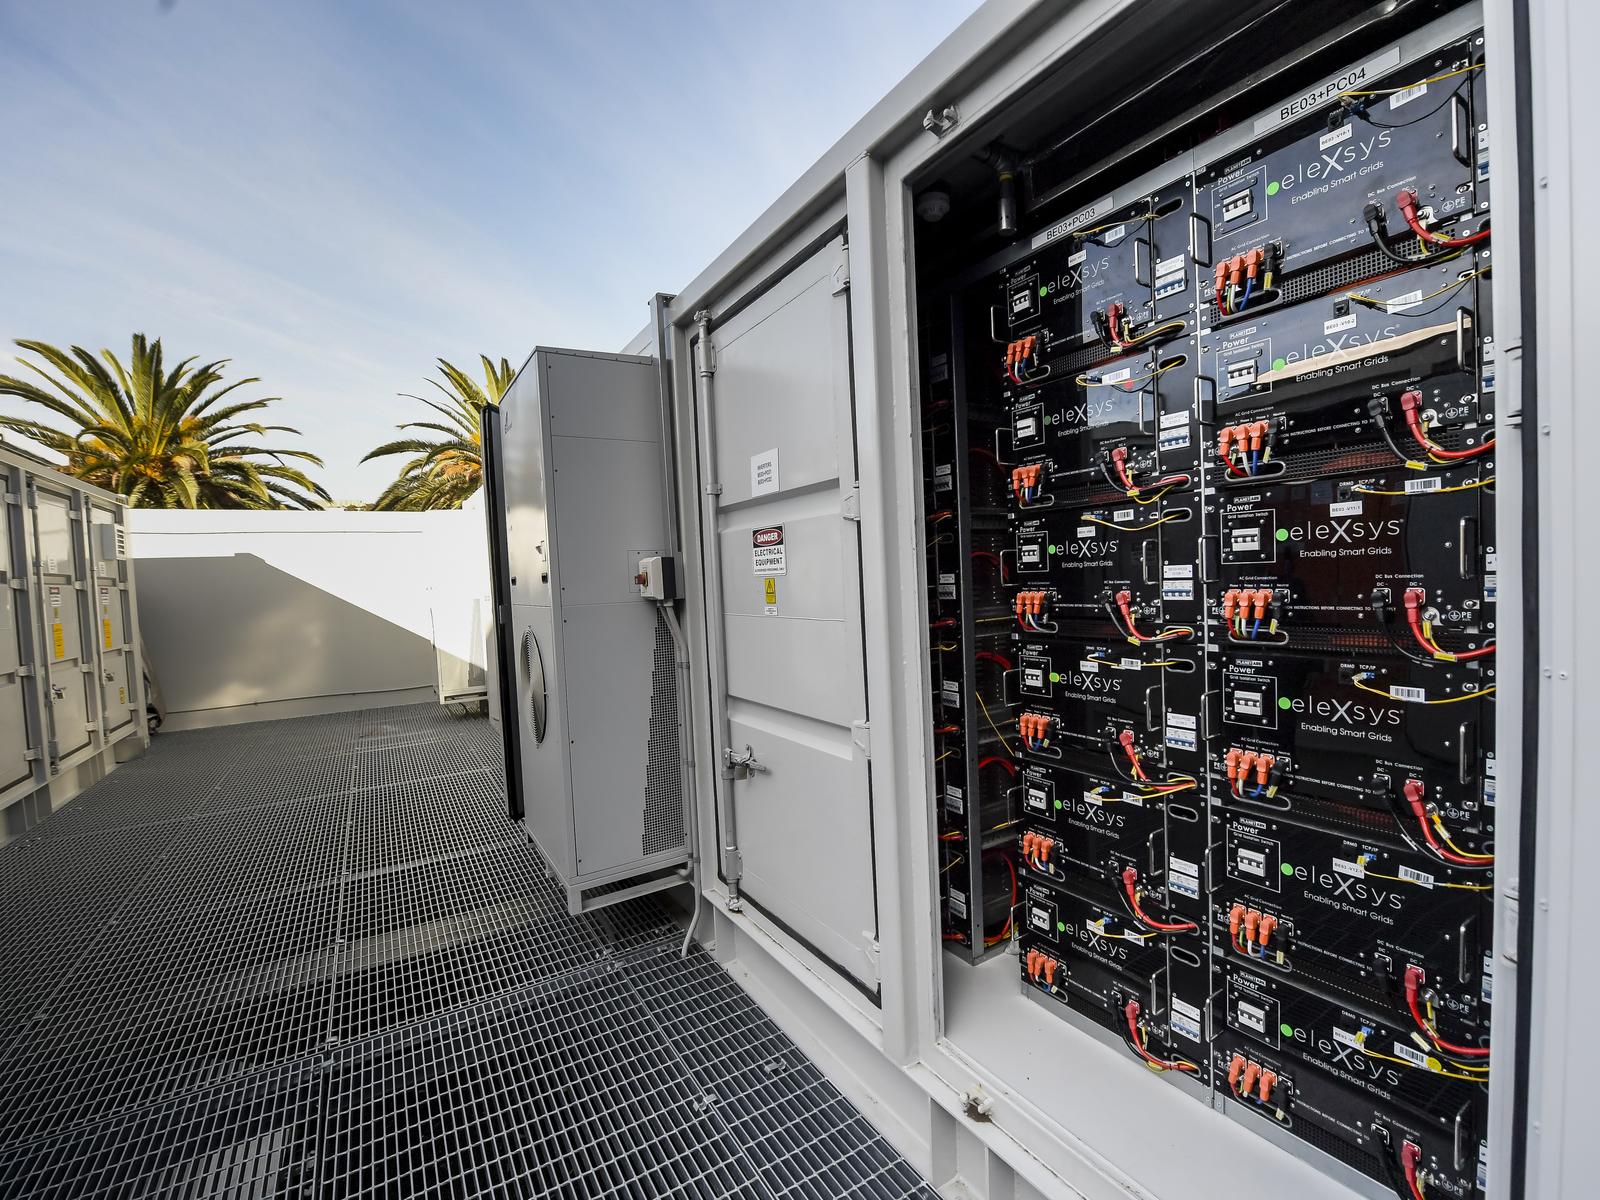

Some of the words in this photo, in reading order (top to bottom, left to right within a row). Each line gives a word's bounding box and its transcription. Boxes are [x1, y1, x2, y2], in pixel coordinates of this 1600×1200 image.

[1280, 67, 1367, 120] BE03+PC04
[1281, 130, 1392, 190] eleXsys
[1217, 169, 1245, 186] Power
[1291, 184, 1329, 205] Enabling
[1330, 172, 1357, 188] Smart
[1359, 161, 1384, 176] Grids
[1046, 208, 1096, 240] BE03+PC03
[1047, 257, 1109, 293] eleXsys
[1053, 292, 1075, 304] Enabling
[1222, 337, 1248, 350] Power
[1286, 326, 1396, 366] eleXsys
[1295, 368, 1333, 382] Enabling
[1335, 361, 1361, 373] Smart
[1363, 355, 1389, 367] Grids
[1391, 376, 1421, 386] Connection
[1052, 399, 1113, 425] eleXsys
[1458, 406, 1469, 414] PE
[1057, 427, 1079, 438] Enabling
[1226, 504, 1253, 512] Power
[757, 532, 778, 542] DANGER
[1290, 519, 1400, 544] eleXsys
[754, 547, 783, 557] ELECTRICAL
[1056, 540, 1117, 558] eleXsys
[1300, 549, 1336, 558] Enabling
[1338, 548, 1365, 556] Smart
[1367, 546, 1392, 555] Grids
[755, 557, 783, 566] EQUIPMENT
[1229, 665, 1255, 674] Power
[1060, 670, 1120, 692] eleXsys
[1065, 691, 1086, 700] Enabling
[1292, 695, 1400, 726] eleXsys
[1301, 722, 1338, 736] Enabling
[1339, 728, 1365, 738] Smart
[1368, 732, 1392, 742] Grids
[1026, 768, 1042, 778] Power
[1395, 762, 1424, 771] Connection
[1063, 798, 1124, 827] eleXsys
[1459, 811, 1470, 819] PE
[1068, 818, 1089, 831] Enabling
[1089, 825, 1105, 835] Smart
[1105, 830, 1120, 839] Grids
[1232, 821, 1259, 835] Power
[1029, 886, 1046, 898] Power
[1295, 865, 1402, 910] eleXsys
[1303, 890, 1340, 909] Enabling
[1342, 902, 1367, 916] Smart
[1370, 911, 1394, 925] Grids
[1066, 923, 1126, 960] eleXsys
[1071, 941, 1093, 957] Enabling
[1233, 973, 1259, 990] Power
[1459, 1004, 1469, 1013] PE
[1294, 1028, 1399, 1086] eleXsys
[1303, 1052, 1339, 1075] Enabling
[1340, 1070, 1365, 1089] Smart
[1367, 1083, 1391, 1100] Grids
[1453, 1186, 1464, 1195] PE
